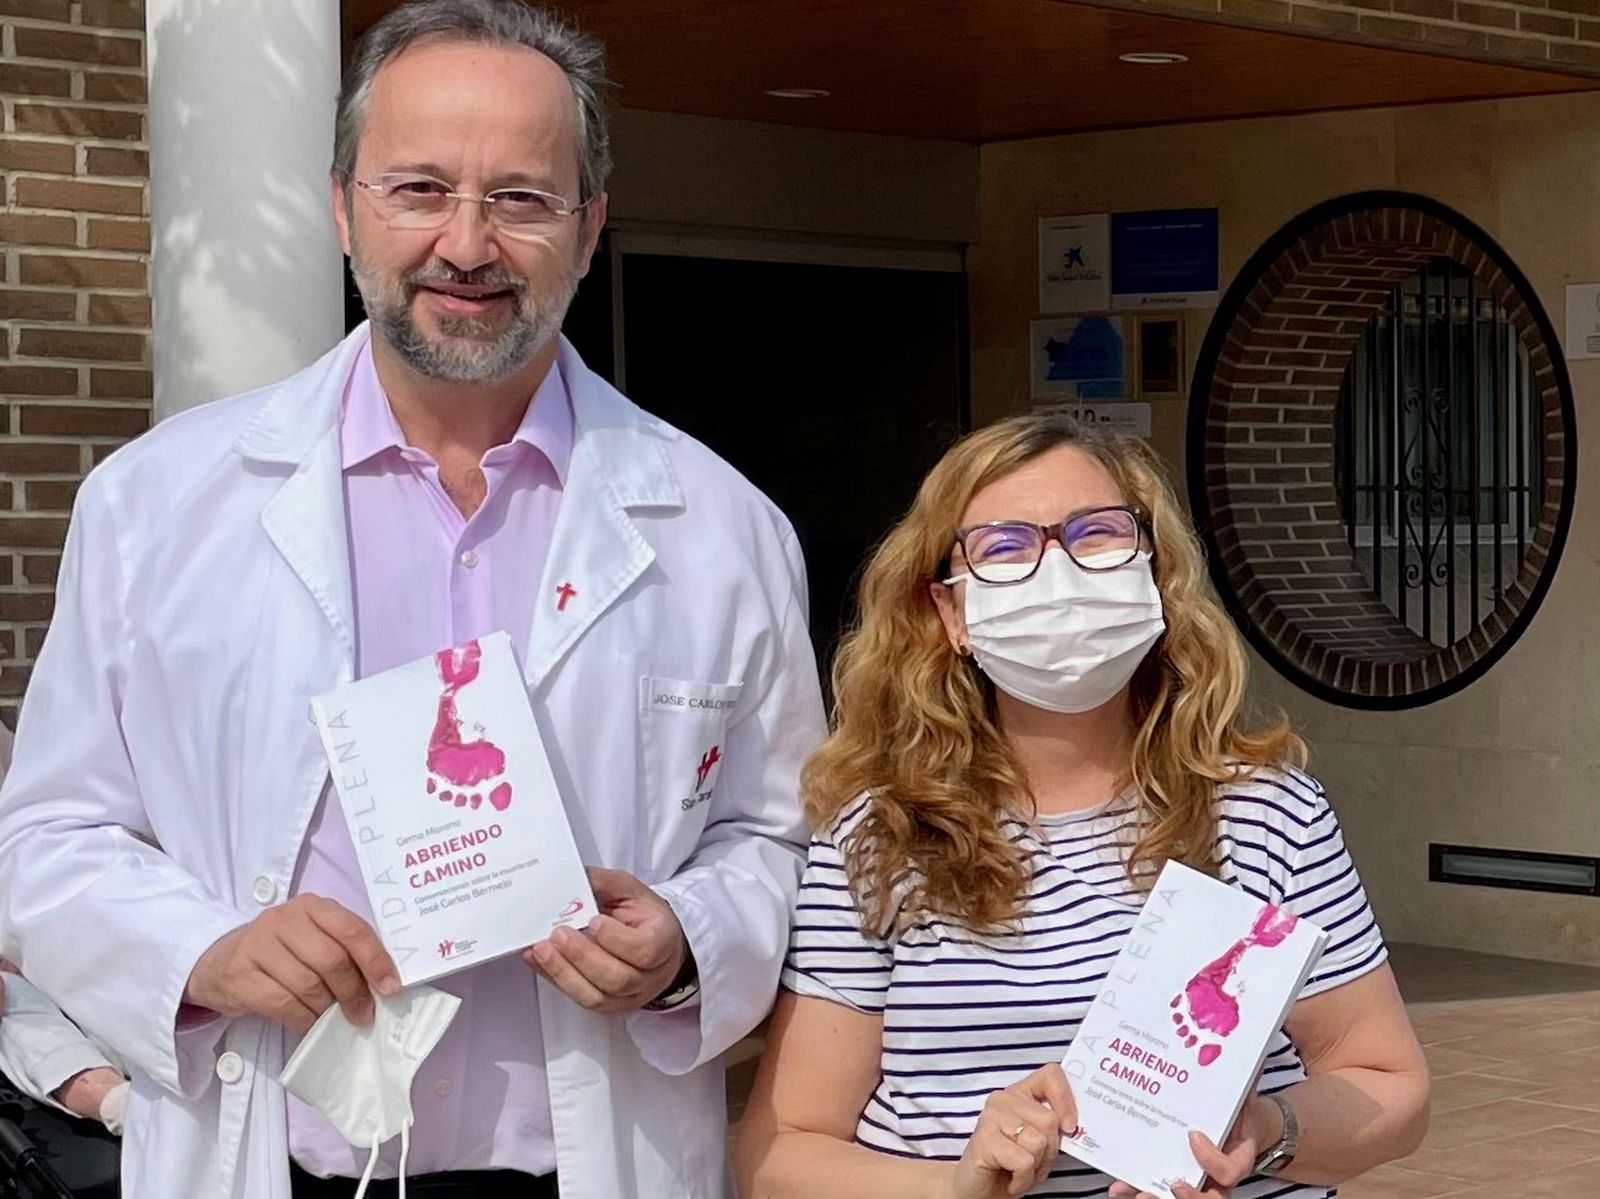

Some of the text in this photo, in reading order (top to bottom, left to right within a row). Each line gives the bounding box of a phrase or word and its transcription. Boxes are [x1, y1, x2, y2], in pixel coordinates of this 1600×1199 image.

[654, 694, 685, 706] JOSE
[688, 698, 726, 710] CARLO
[327, 710, 419, 965] VIDA PLENA
[404, 823, 503, 869] ABRIENDO
[409, 852, 487, 889] CAMINO
[418, 879, 513, 917] José Carlos Bermejo
[1066, 890, 1180, 1080] DA PLENA
[1099, 1057, 1161, 1095] CAMINO
[1108, 1038, 1190, 1084] ABRIENDO
